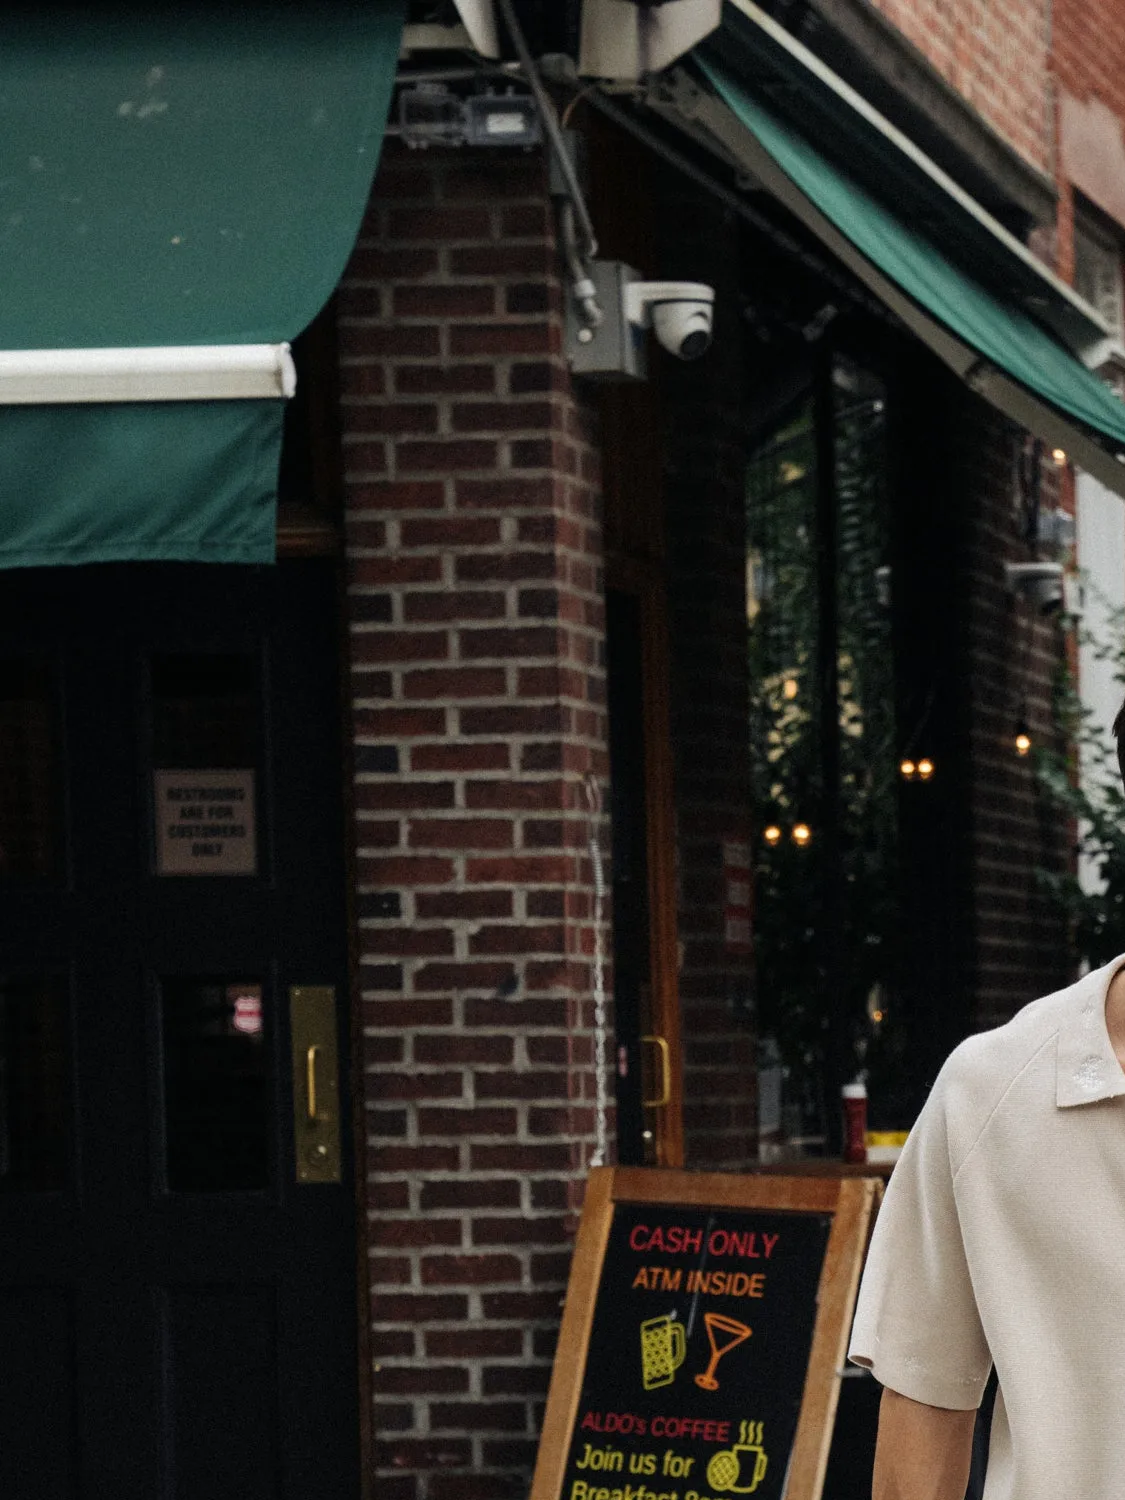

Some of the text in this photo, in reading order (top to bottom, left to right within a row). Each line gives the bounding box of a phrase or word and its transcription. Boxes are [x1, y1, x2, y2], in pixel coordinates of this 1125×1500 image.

[629, 1224, 780, 1259] CASH ONLY
[632, 1266, 767, 1298] ATM INSIDE
[651, 1416, 731, 1442] COFFEE
[576, 1443, 695, 1478] Join us for
